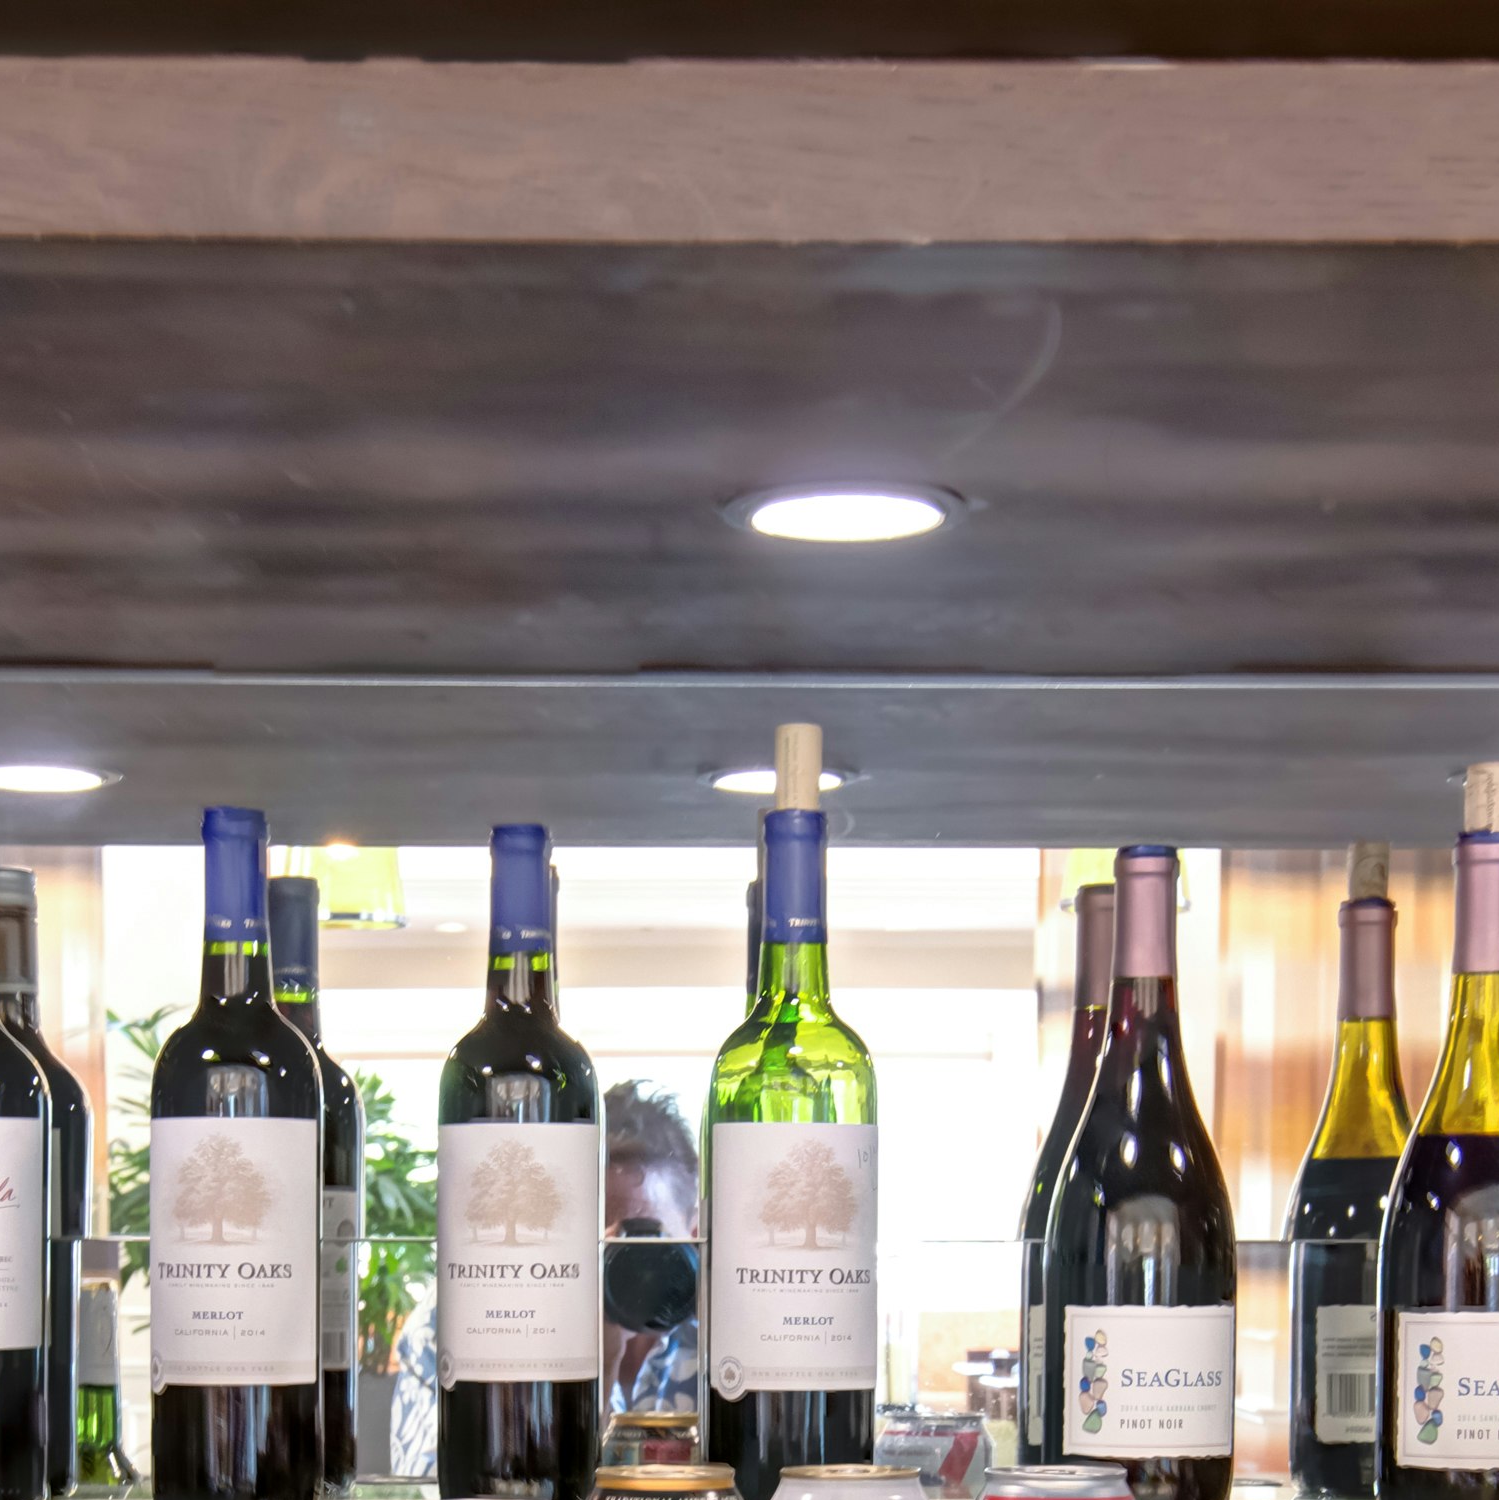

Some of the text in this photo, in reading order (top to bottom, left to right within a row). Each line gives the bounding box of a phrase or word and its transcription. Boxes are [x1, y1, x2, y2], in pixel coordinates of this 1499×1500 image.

[158, 1262, 292, 1280] TRINITY OAKS
[448, 1263, 580, 1280] TRINITY OAKS
[736, 1268, 870, 1285] TRINITY OAKS
[192, 1311, 244, 1320] MERLOT
[486, 1310, 536, 1319] MERLOT
[782, 1316, 834, 1326] MERLOT
[174, 1329, 266, 1337] CALIFORNIA 2014
[466, 1327, 557, 1335] CALIFORNIA 2014
[760, 1334, 852, 1342] CALIFORNIA 2014
[1121, 1368, 1222, 1388] SEAGLASS
[1120, 1418, 1184, 1429] PINOT NOIR
[1457, 1429, 1493, 1440] PINOT
